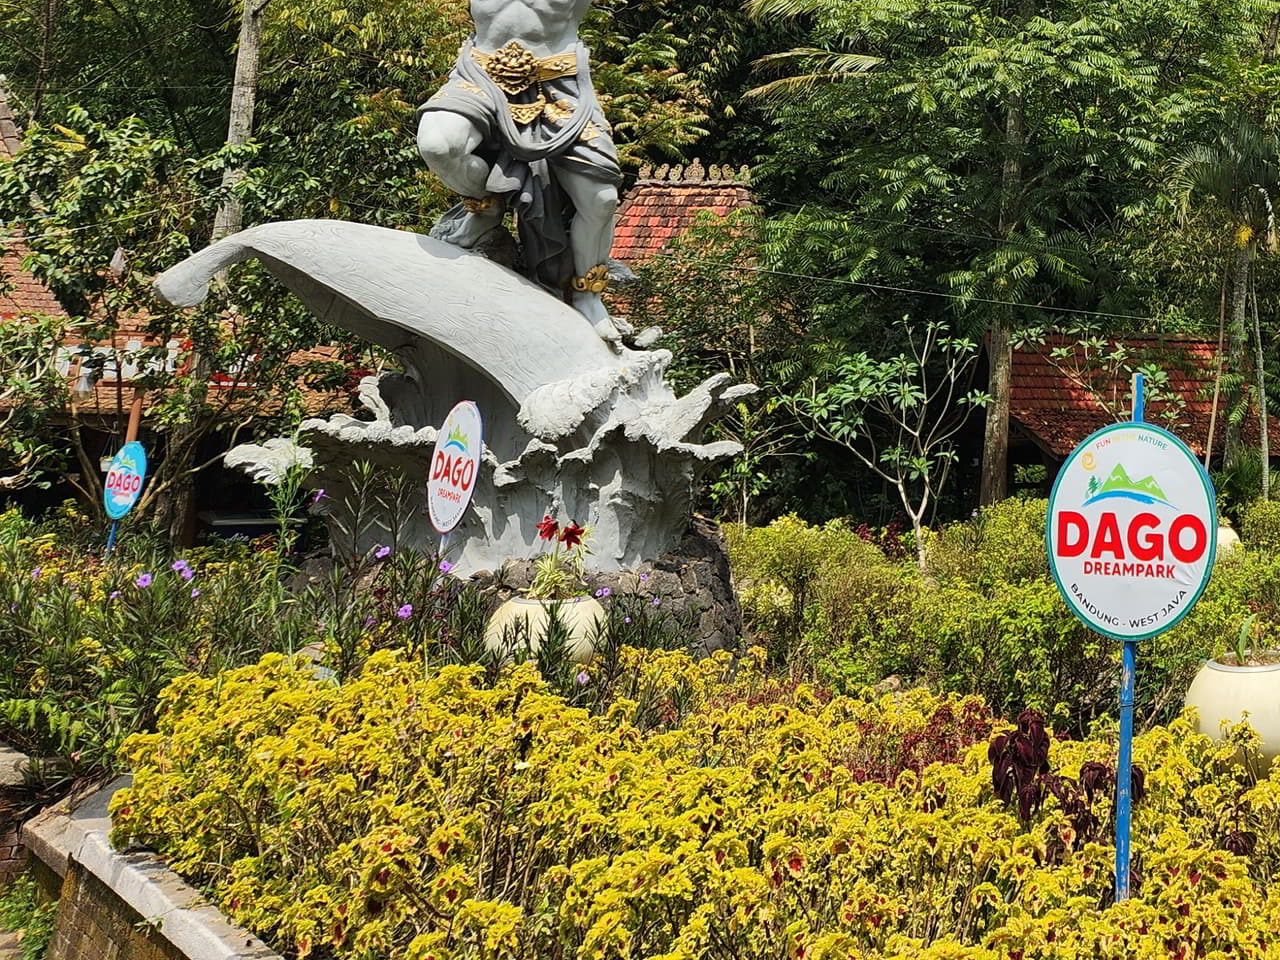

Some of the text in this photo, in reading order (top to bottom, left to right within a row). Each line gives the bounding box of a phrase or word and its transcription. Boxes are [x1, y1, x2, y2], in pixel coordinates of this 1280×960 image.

[1095, 438, 1111, 450] FUN
[1137, 434, 1168, 450] NATURE
[107, 471, 140, 492] DAGO
[433, 450, 474, 491] DAGO
[1056, 510, 1208, 564] DAGO
[1083, 561, 1176, 579] DREAMPARK
[1071, 583, 1119, 627] BANDUNG
[1128, 612, 1160, 628] WEST
[1161, 590, 1187, 617] JAVA
